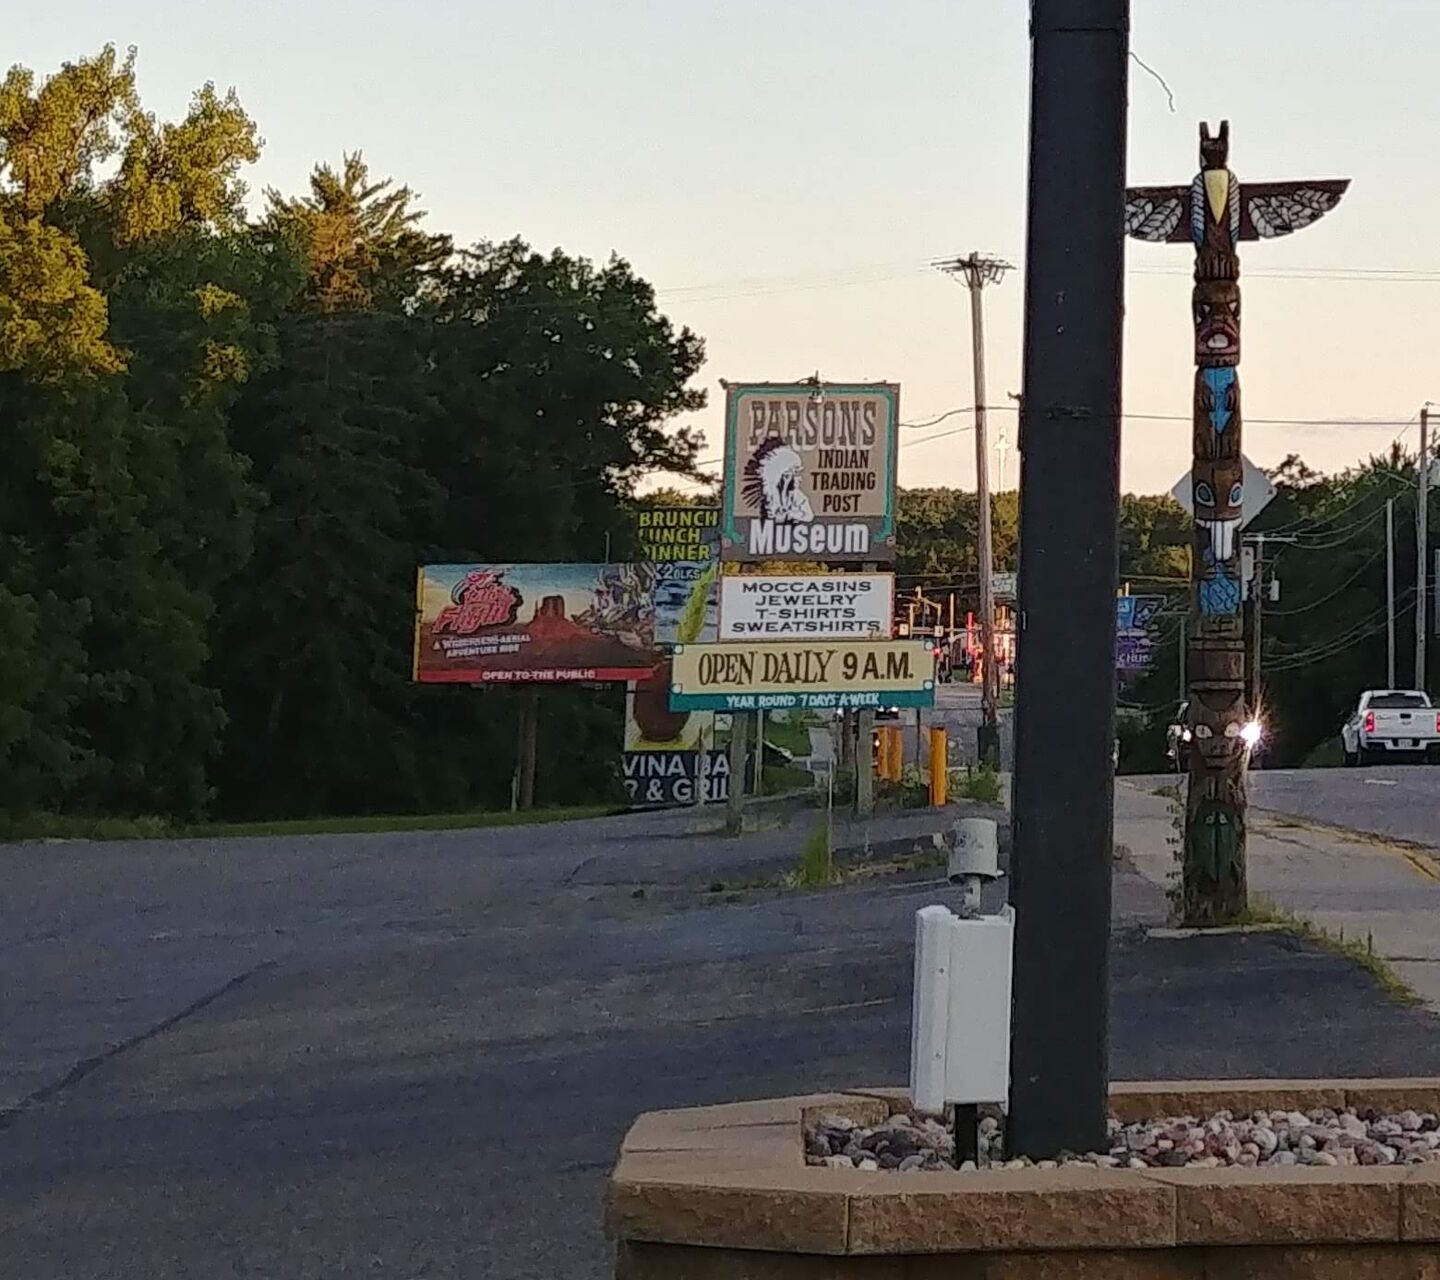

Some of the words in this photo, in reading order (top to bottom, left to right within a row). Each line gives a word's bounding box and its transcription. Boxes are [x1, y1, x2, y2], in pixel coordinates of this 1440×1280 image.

[749, 400, 877, 449] PARSONS
[818, 449, 869, 469] INDIAN
[810, 472, 876, 491] TRADING
[823, 494, 861, 512] POST
[640, 511, 718, 527] BRUNCH
[750, 519, 869, 555] Museum
[742, 581, 872, 593] MOCCASINS
[755, 595, 858, 606] JEWELRY
[757, 608, 856, 619] T-SHIRTS
[732, 621, 881, 633] SWEATSHIRTS
[482, 671, 511, 680] OPEN
[556, 670, 595, 679] PUBLIC
[699, 651, 756, 686] OPEN
[761, 649, 837, 684] DAILY
[842, 652, 858, 680] 9
[862, 652, 914, 680] A.M.
[726, 695, 755, 708] YEAR
[758, 695, 796, 707] ROUND
[802, 696, 808, 707] 7
[808, 695, 836, 707] DAYS
[849, 693, 879, 705] WEEK
[646, 779, 663, 800] &
